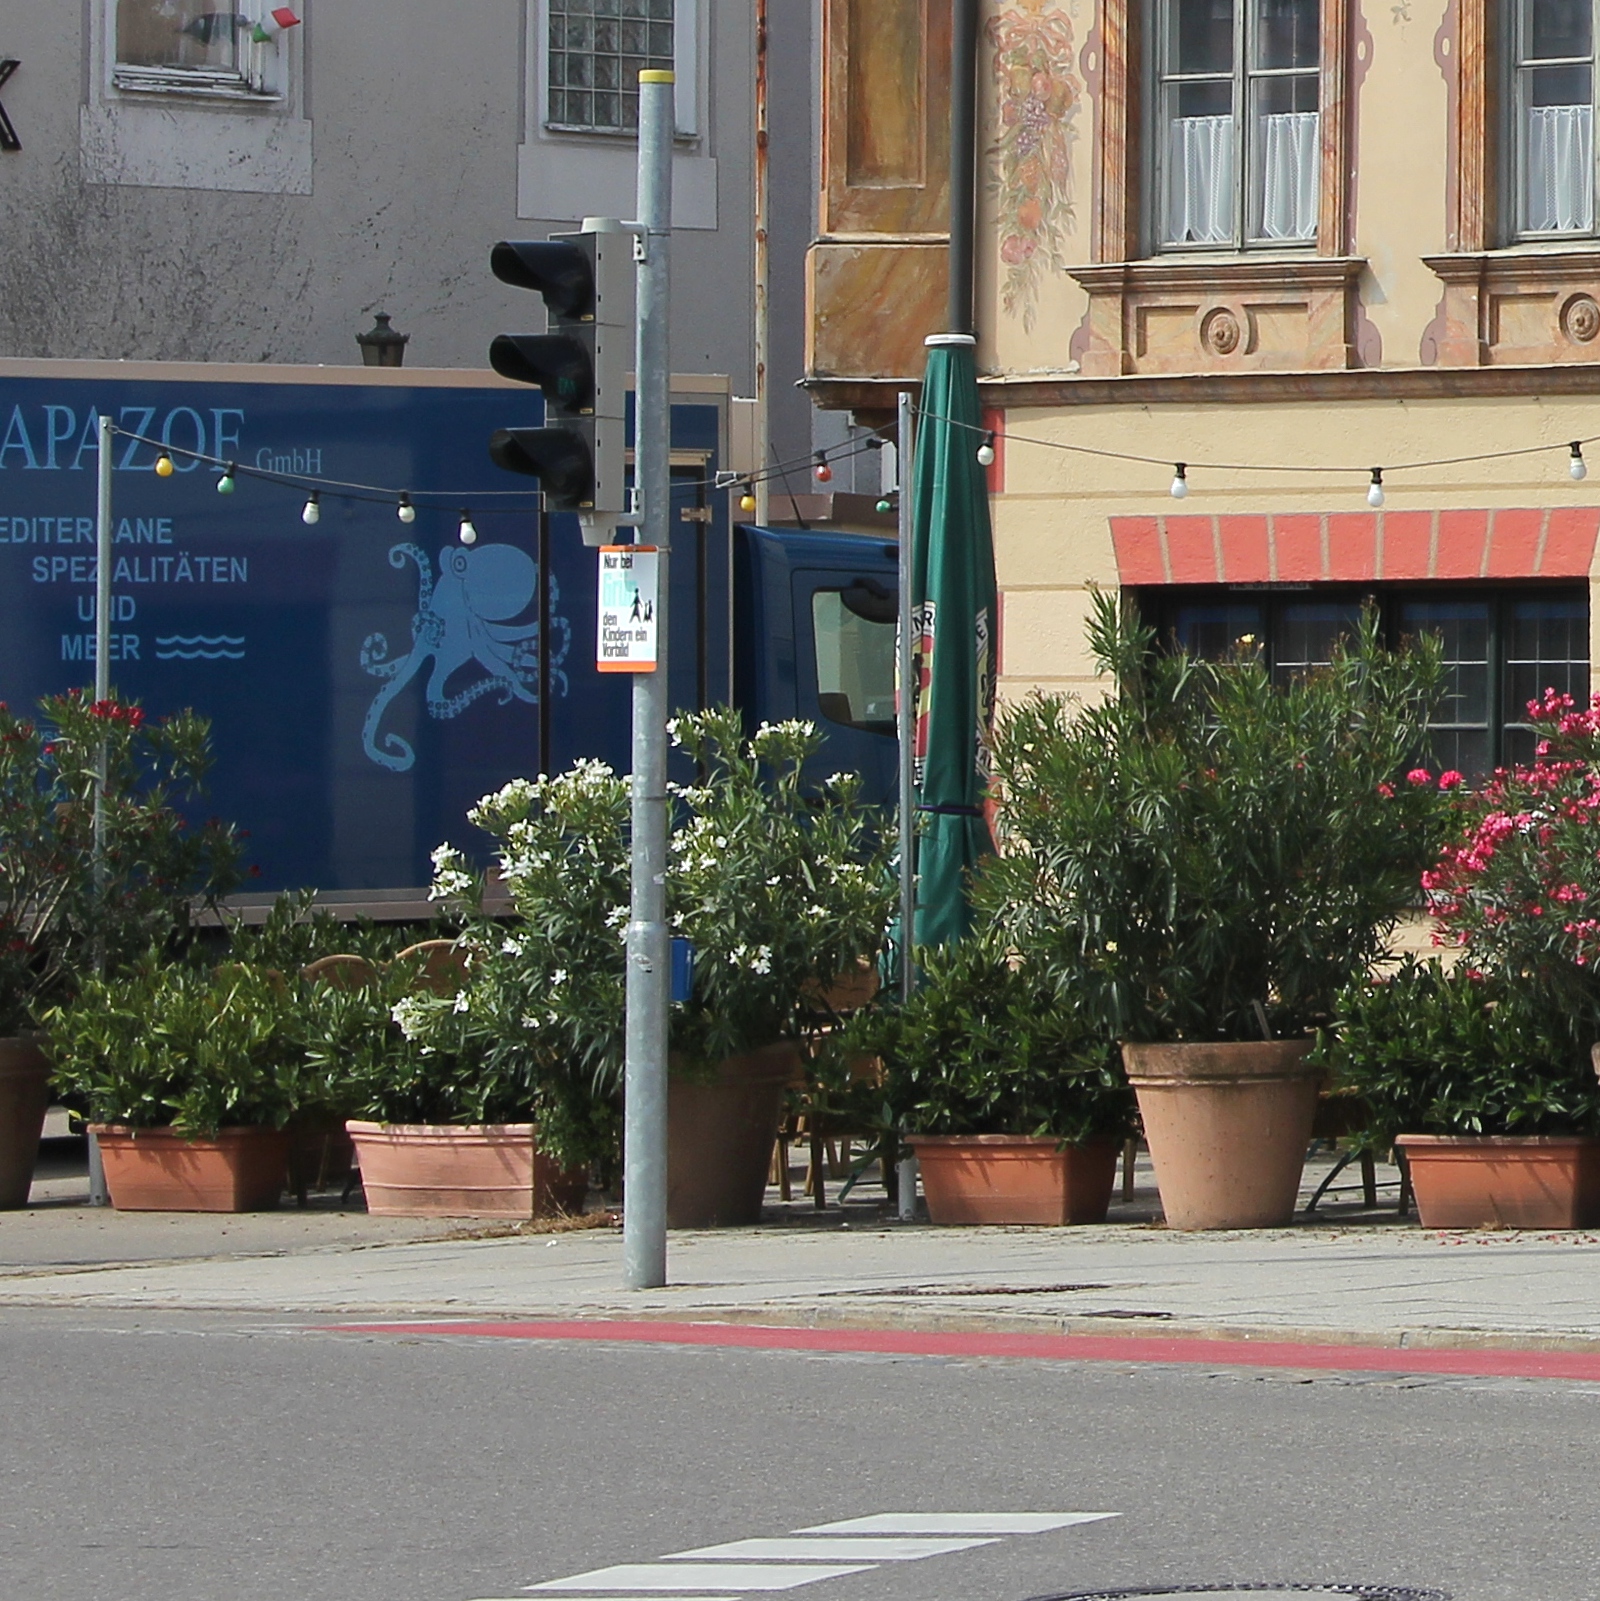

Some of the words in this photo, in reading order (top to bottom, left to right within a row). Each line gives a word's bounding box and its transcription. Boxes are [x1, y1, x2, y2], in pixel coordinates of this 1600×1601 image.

[256, 446, 324, 474] GmbH
[32, 552, 248, 583] SPEZALITÄTEN
[603, 554, 618, 569] Nur
[620, 552, 634, 569] bei
[602, 612, 618, 626] den
[602, 627, 633, 642] Kindern
[635, 627, 648, 642] ein
[602, 643, 629, 657] Vorbild
